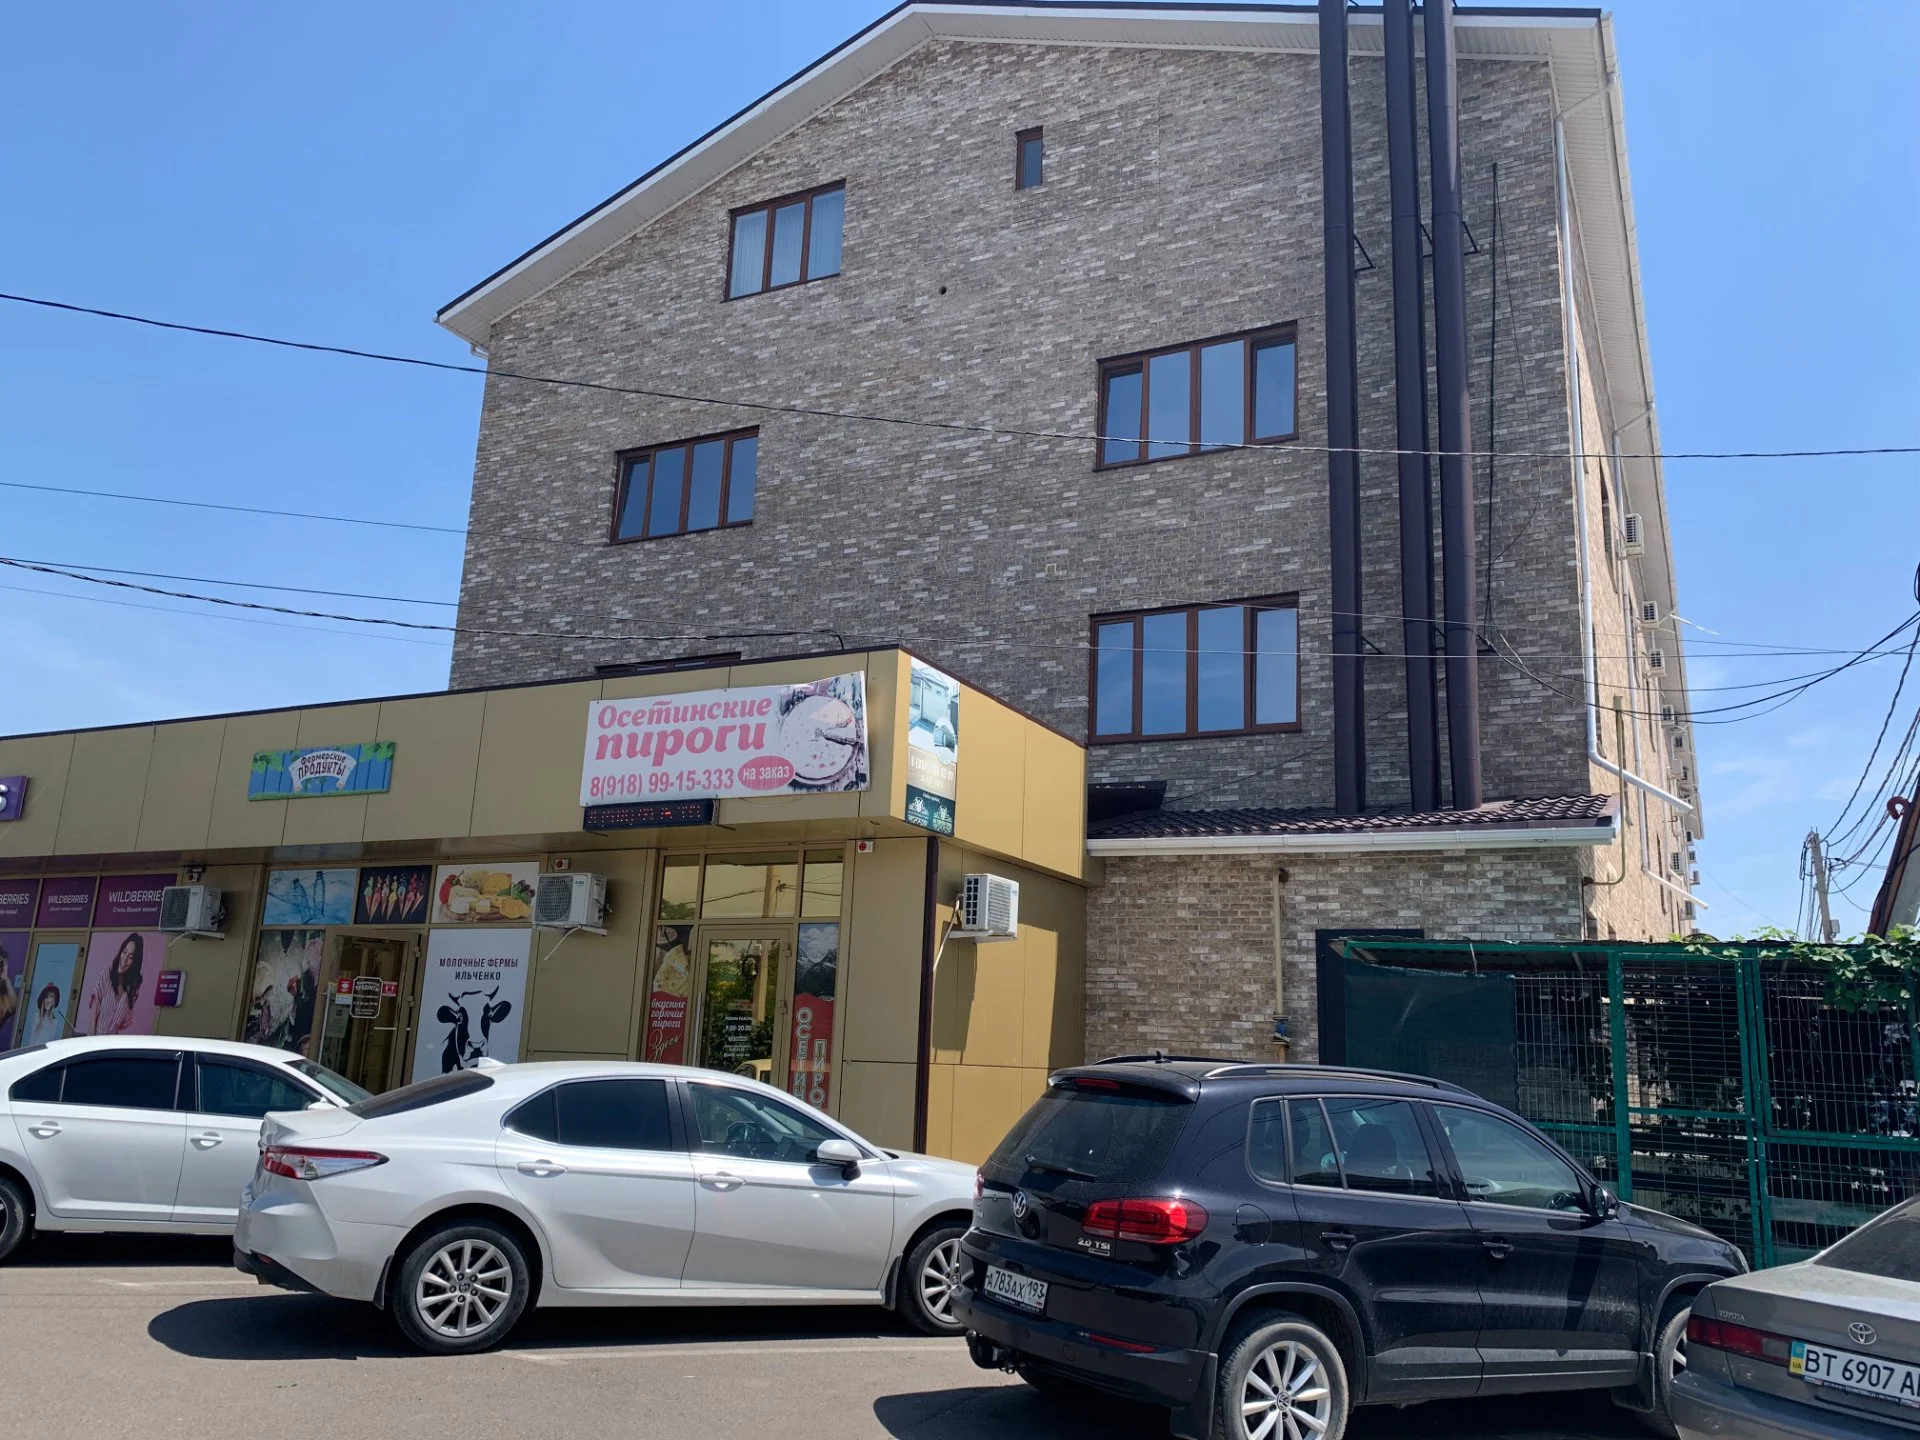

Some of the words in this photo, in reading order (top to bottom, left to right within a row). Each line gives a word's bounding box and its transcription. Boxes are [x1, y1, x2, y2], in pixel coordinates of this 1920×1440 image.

[597, 697, 772, 729] Осетинские
[595, 722, 767, 767] пироги
[301, 753, 346, 765] Фермерские
[298, 762, 347, 780] ПРОДУКТЫ
[743, 766, 757, 780] на
[759, 763, 790, 780] заказ
[589, 773, 643, 799] 8(918)
[649, 768, 735, 792] 99-15-333
[48, 894, 89, 904] WILDBERRIES
[439, 958, 486, 968] МОЛОЧНЫЕ
[487, 958, 518, 968] ФЕРМЫ
[455, 971, 501, 981] ИЛЬЧЕНКО
[651, 1020, 681, 1030] пироги
[1078, 1238, 1092, 1247] 2.0
[1094, 1241, 1110, 1250] TSI
[1027, 1280, 1044, 1298] 193
[1719, 1309, 1745, 1321] TOYOTA
[1792, 1362, 1802, 1370] UA
[1805, 1350, 1837, 1377] BT
[1842, 1358, 1895, 1390] 6907
[1899, 1371, 1920, 1397] A
